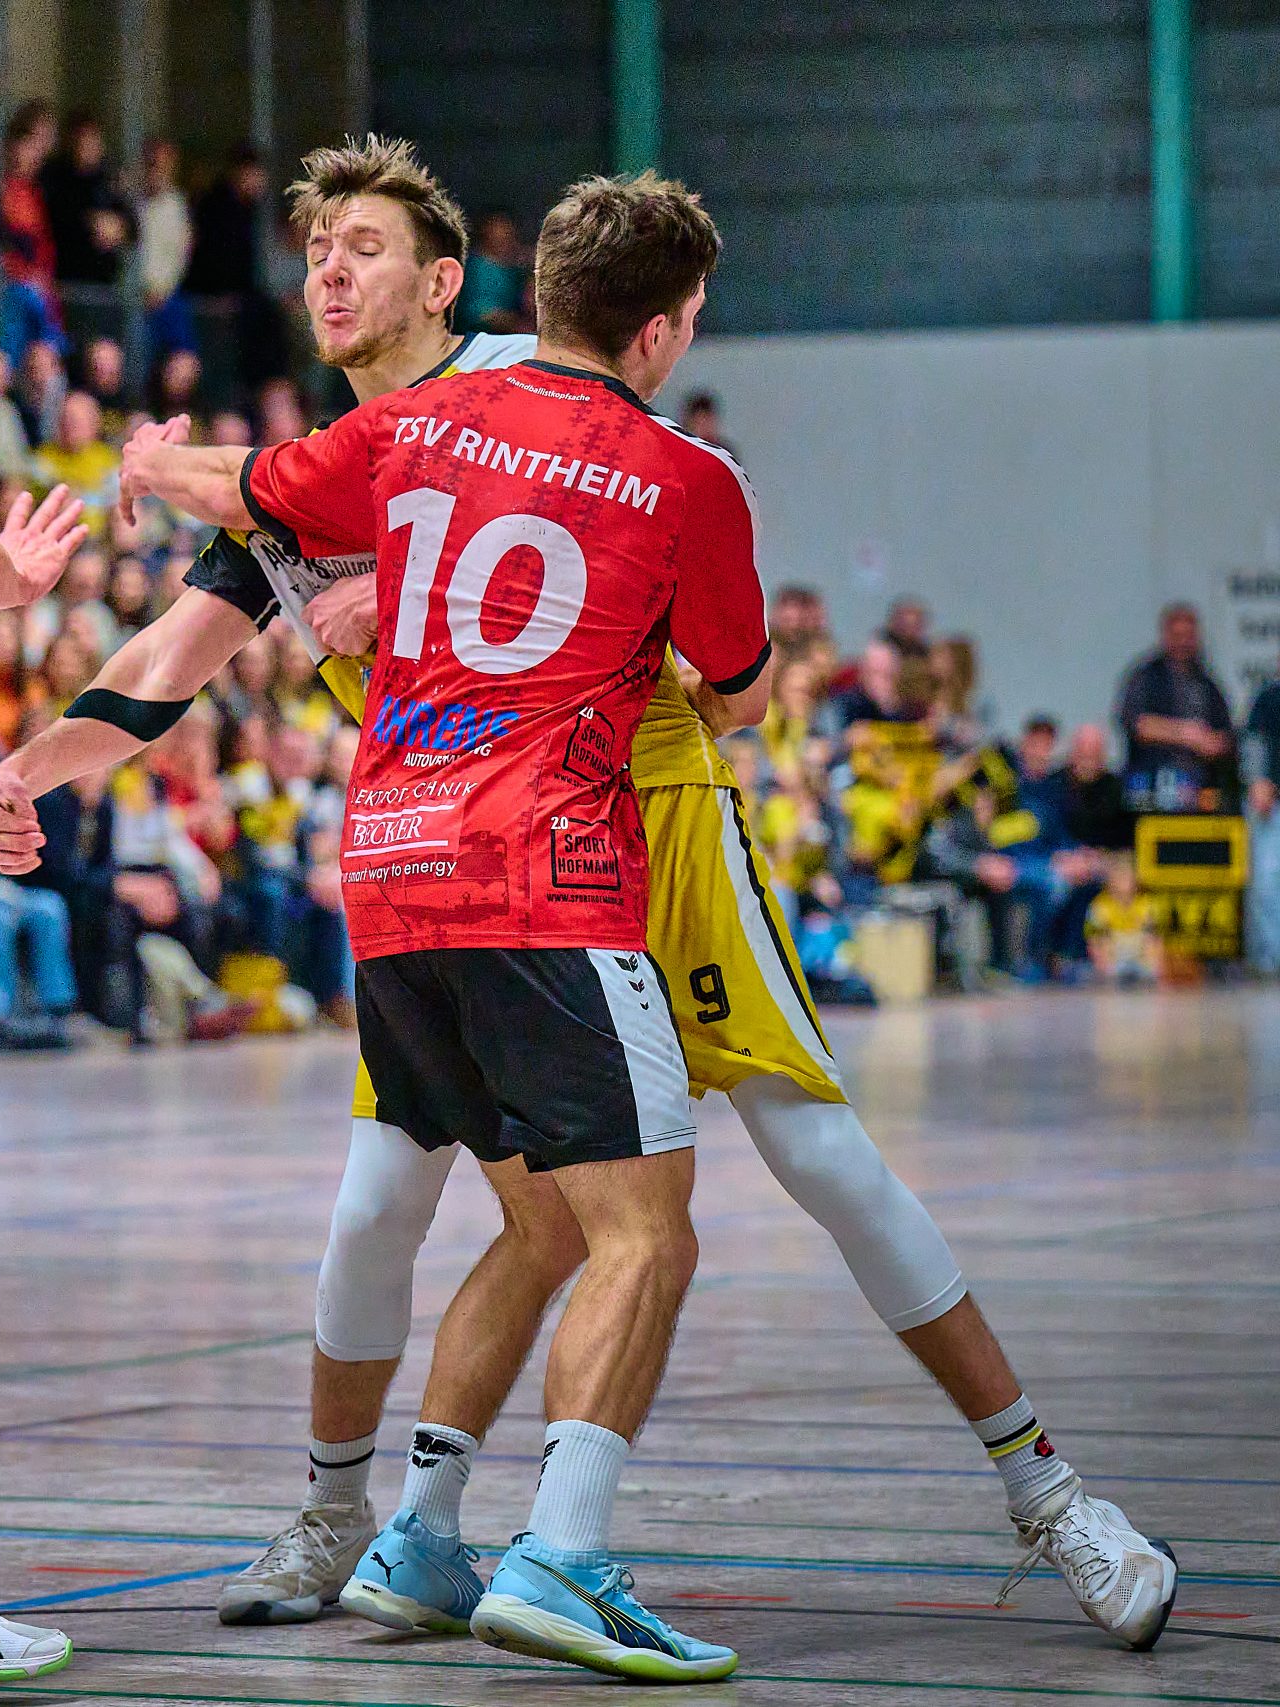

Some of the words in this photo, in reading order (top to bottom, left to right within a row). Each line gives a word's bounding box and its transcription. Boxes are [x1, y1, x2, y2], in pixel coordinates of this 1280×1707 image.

[394, 417, 453, 447] TSV
[452, 427, 662, 516] RINTHEIM
[387, 487, 588, 675] 10
[353, 816, 423, 846] BECKER
[564, 833, 607, 854] SPORT
[369, 865, 389, 883] way
[391, 863, 402, 877] to
[404, 861, 458, 877] energy
[557, 857, 615, 875] HOFMANN
[689, 963, 731, 1024] 9
